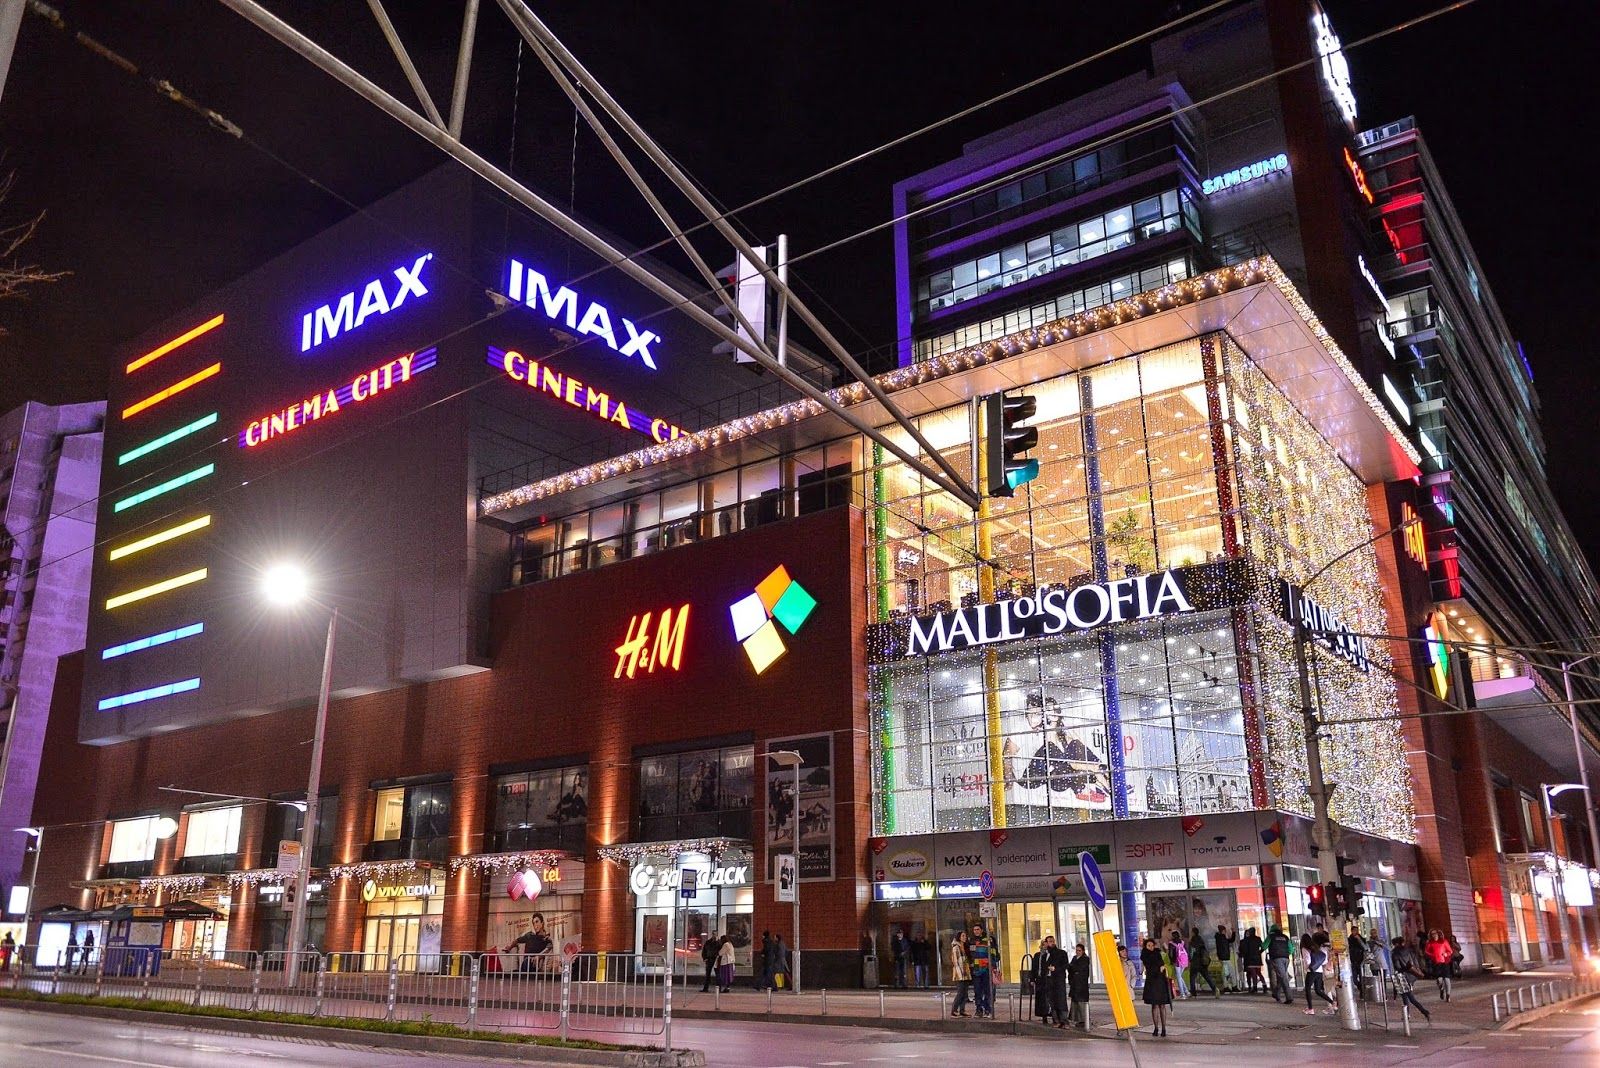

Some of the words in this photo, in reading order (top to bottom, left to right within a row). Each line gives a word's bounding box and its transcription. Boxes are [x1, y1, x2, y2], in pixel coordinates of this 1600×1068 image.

[1202, 154, 1288, 195] SAMSUNG
[302, 252, 432, 352] IMAX
[509, 258, 660, 371] IMAX
[245, 388, 340, 447] CINEMA
[352, 352, 415, 402] CITY
[503, 351, 631, 430] CINEMA
[905, 599, 1025, 656] MALL
[1013, 583, 1049, 619] of
[1043, 570, 1195, 634] SOFIA
[614, 603, 690, 679] H&M
[1186, 819, 1203, 834] NEW
[891, 859, 926, 869] Bakers
[997, 853, 1047, 865] goldenpoint
[1125, 842, 1174, 858] ESPRIT
[1216, 845, 1251, 853] TAILOR
[378, 884, 436, 897] VIVACOM
[711, 866, 748, 886] ДСК
